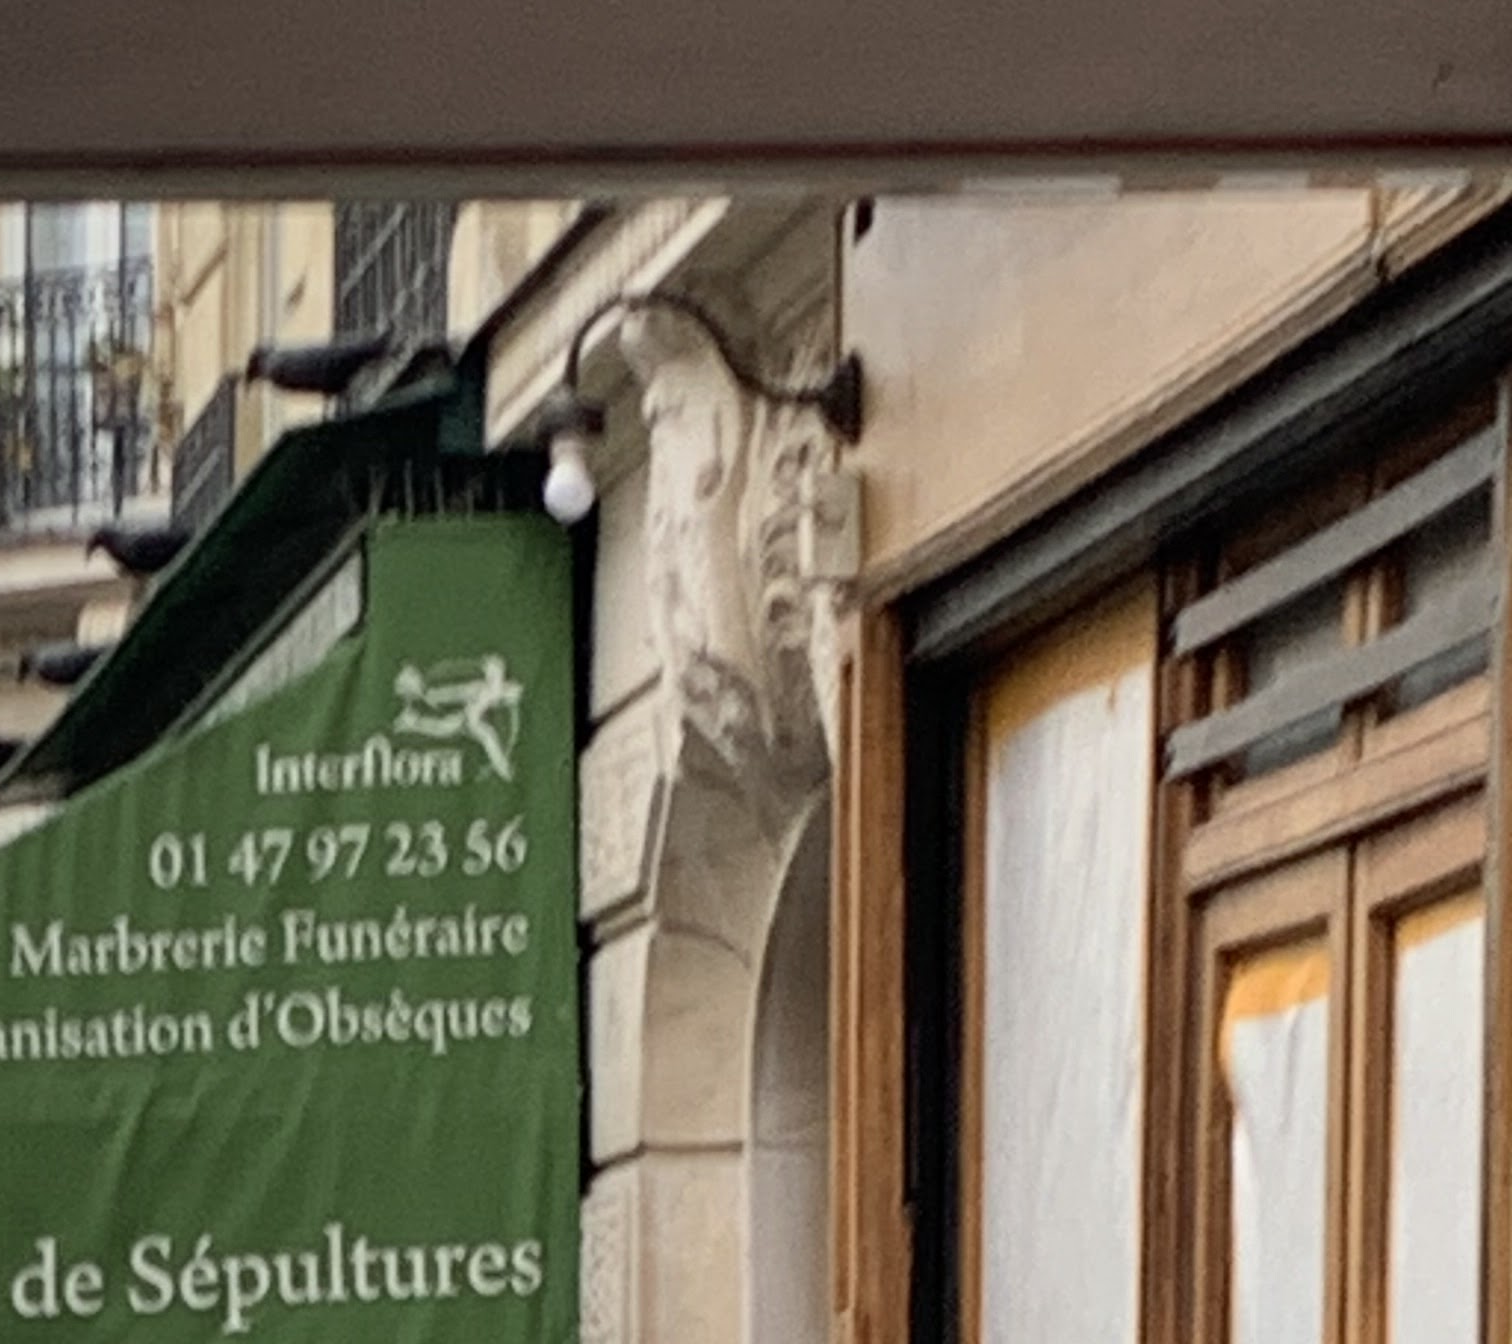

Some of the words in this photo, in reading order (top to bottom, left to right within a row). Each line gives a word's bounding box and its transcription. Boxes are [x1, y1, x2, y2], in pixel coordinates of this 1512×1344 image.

[255, 735, 464, 795] Interflora
[149, 830, 208, 889] 01
[228, 827, 294, 888] 47
[306, 822, 371, 884] 97
[385, 818, 449, 878] 23
[461, 814, 529, 877] 56
[10, 912, 268, 978] Marbrerie
[282, 902, 530, 965] Funéraire
[228, 986, 533, 1056] d'Obsèques
[10, 1235, 105, 1319] de
[127, 1221, 544, 1335] Sépultures
